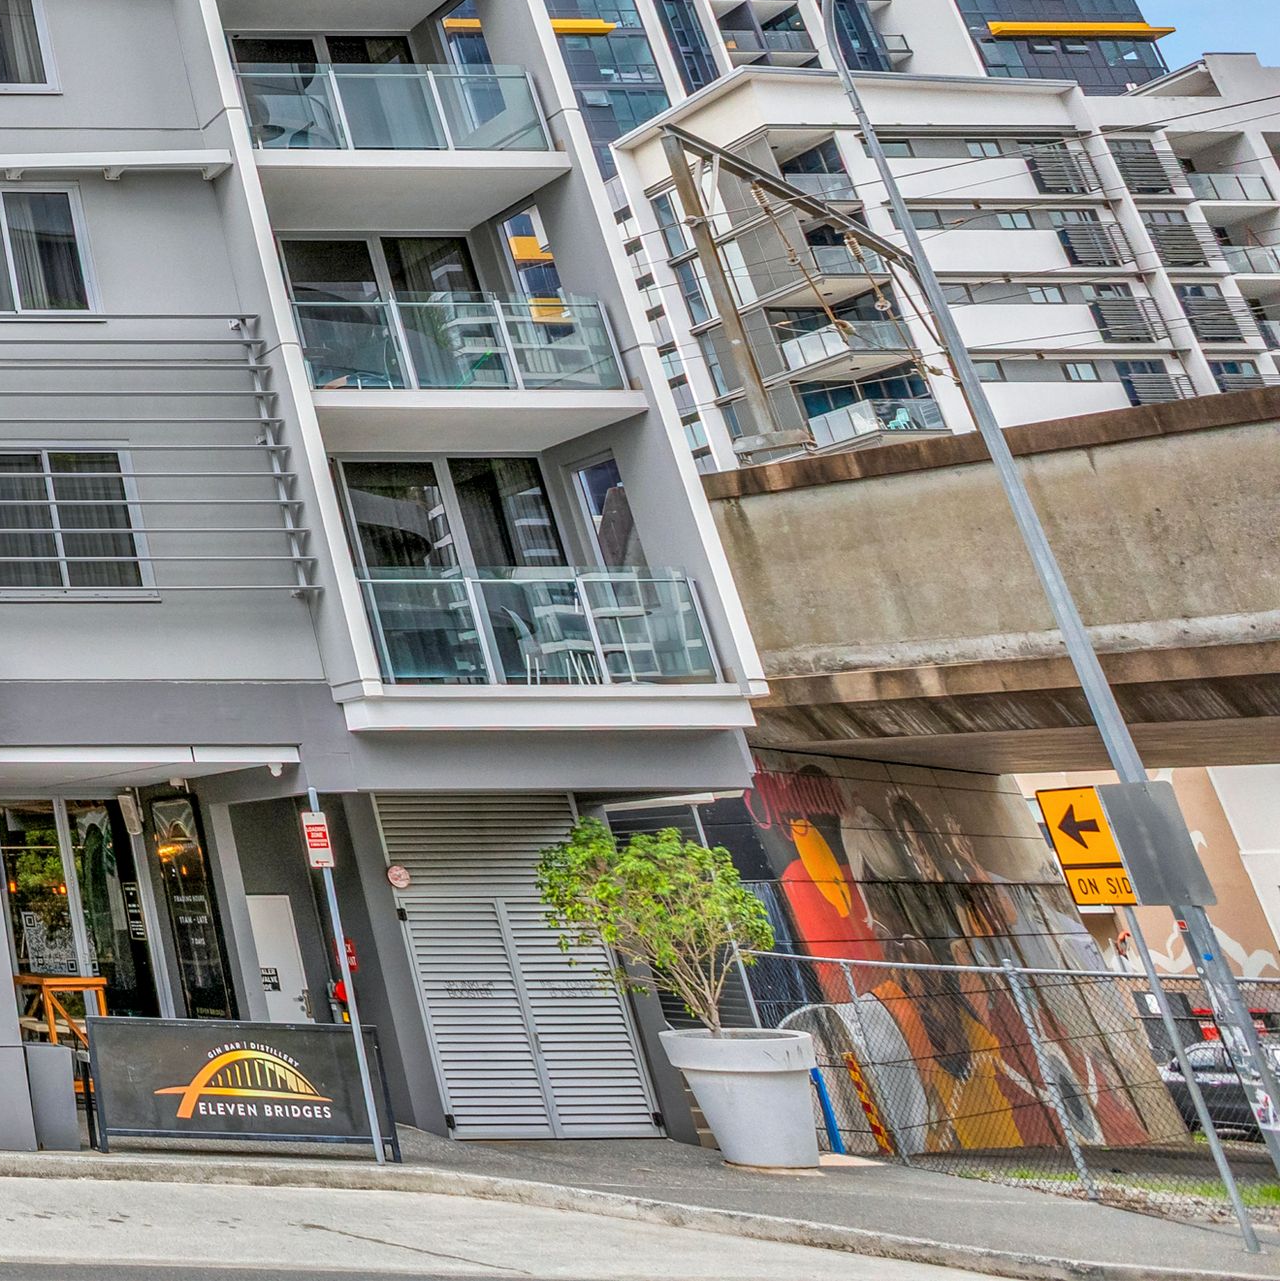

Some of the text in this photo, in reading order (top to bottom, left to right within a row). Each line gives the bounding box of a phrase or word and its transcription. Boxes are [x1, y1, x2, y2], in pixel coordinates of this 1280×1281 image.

[1078, 877, 1133, 895] ON SID
[207, 1041, 300, 1068] GIN BAR DISTILLERY
[198, 1102, 333, 1119] ELEVEN BRIDGES
